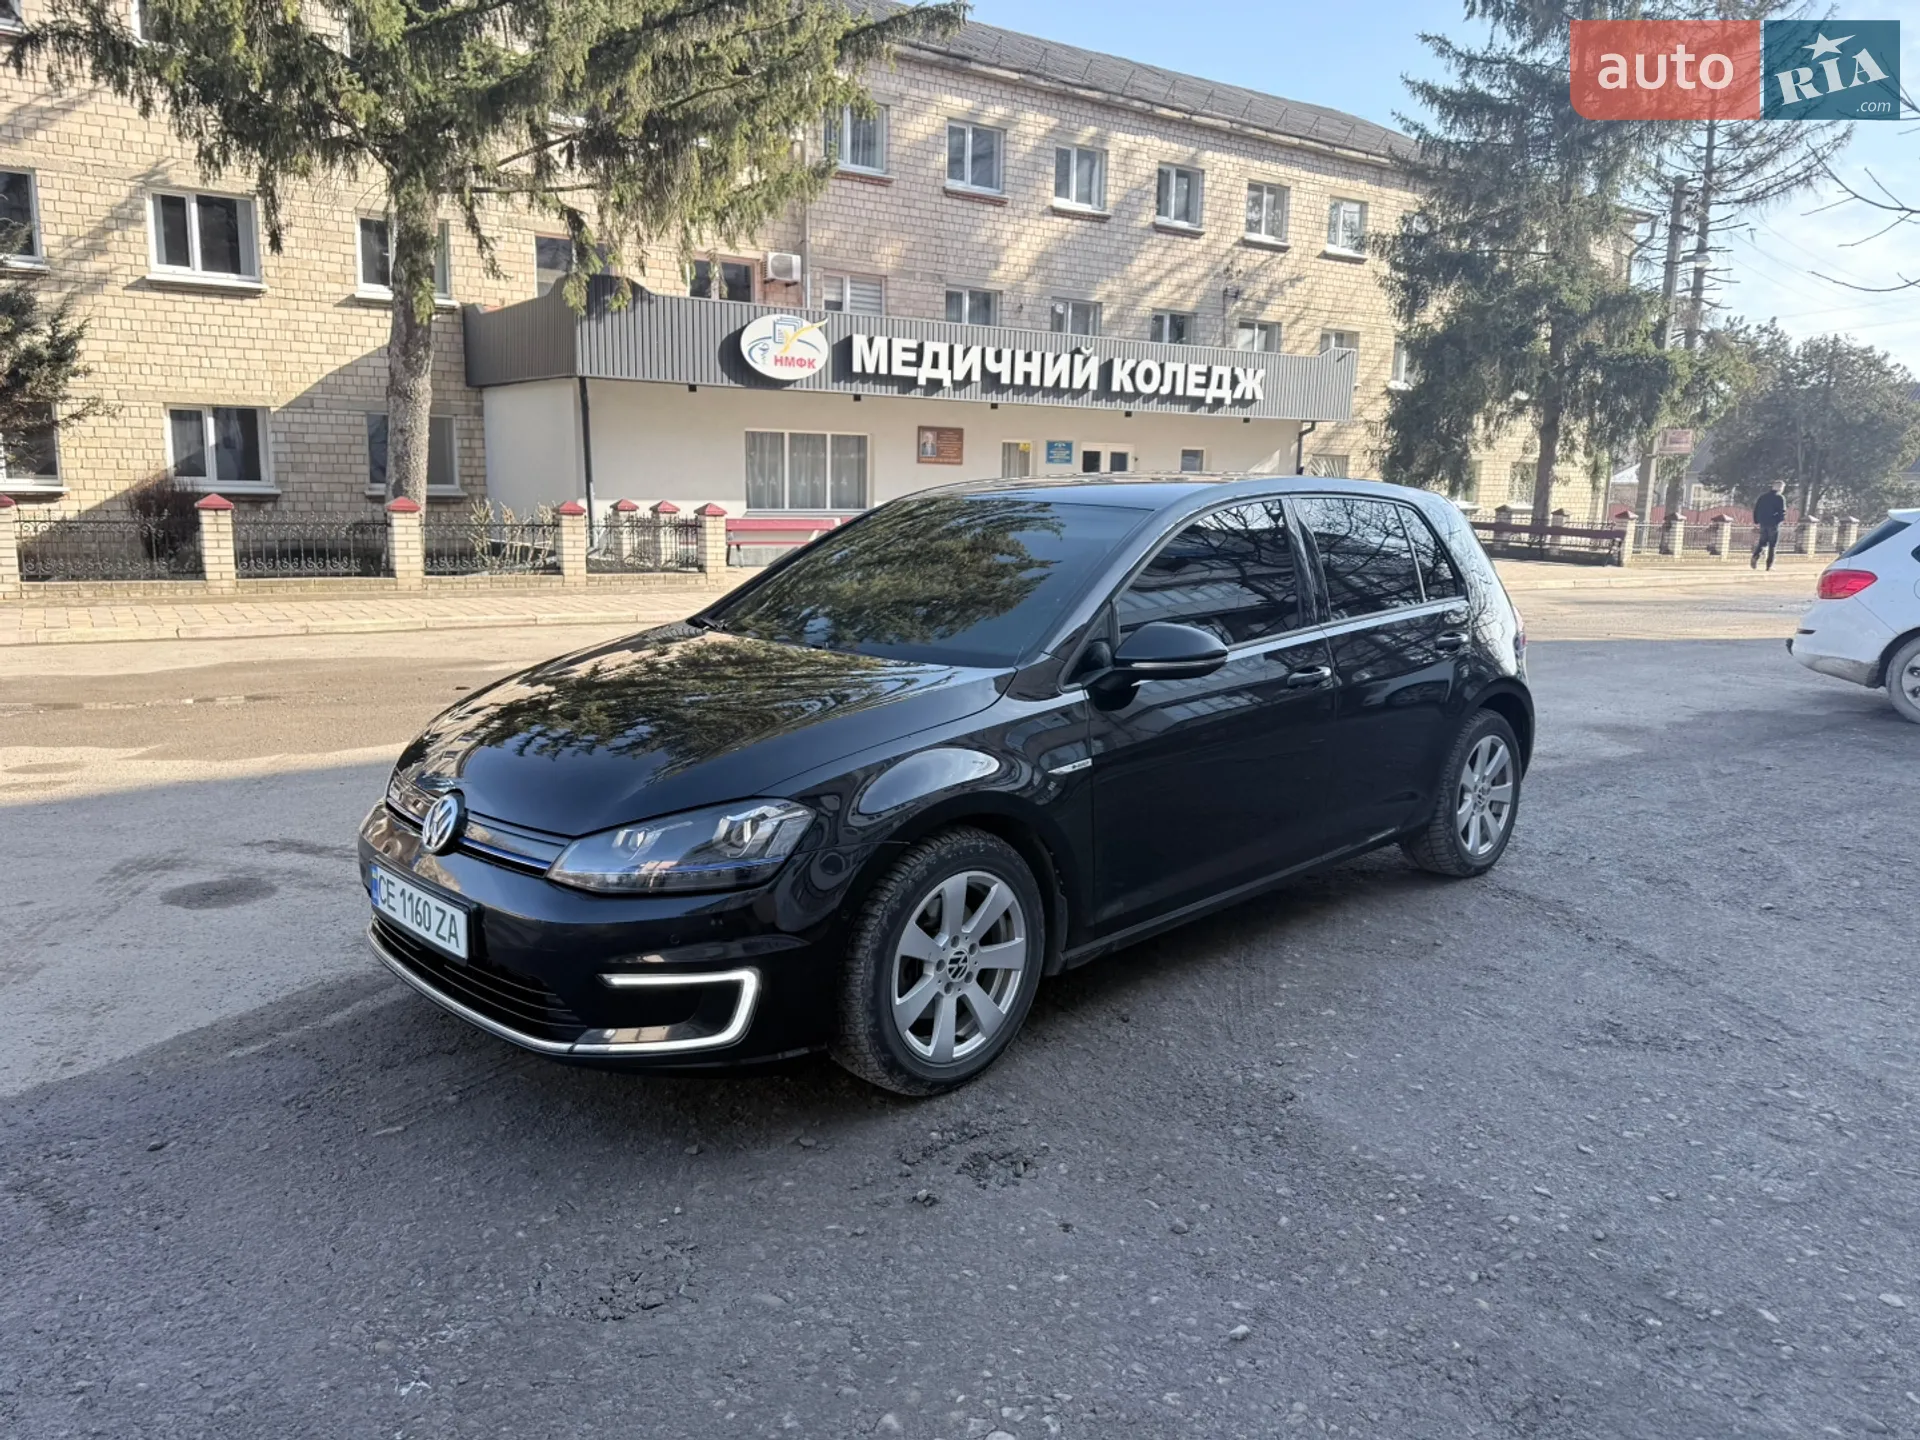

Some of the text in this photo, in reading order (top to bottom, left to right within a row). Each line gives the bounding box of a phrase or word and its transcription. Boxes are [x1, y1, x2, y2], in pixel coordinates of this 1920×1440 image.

[774, 355, 816, 369] НМФК
[852, 333, 1266, 405] МЕДИЧНИЙ КОЛЕДЖ
[379, 875, 460, 949] CE 1160 ZA
